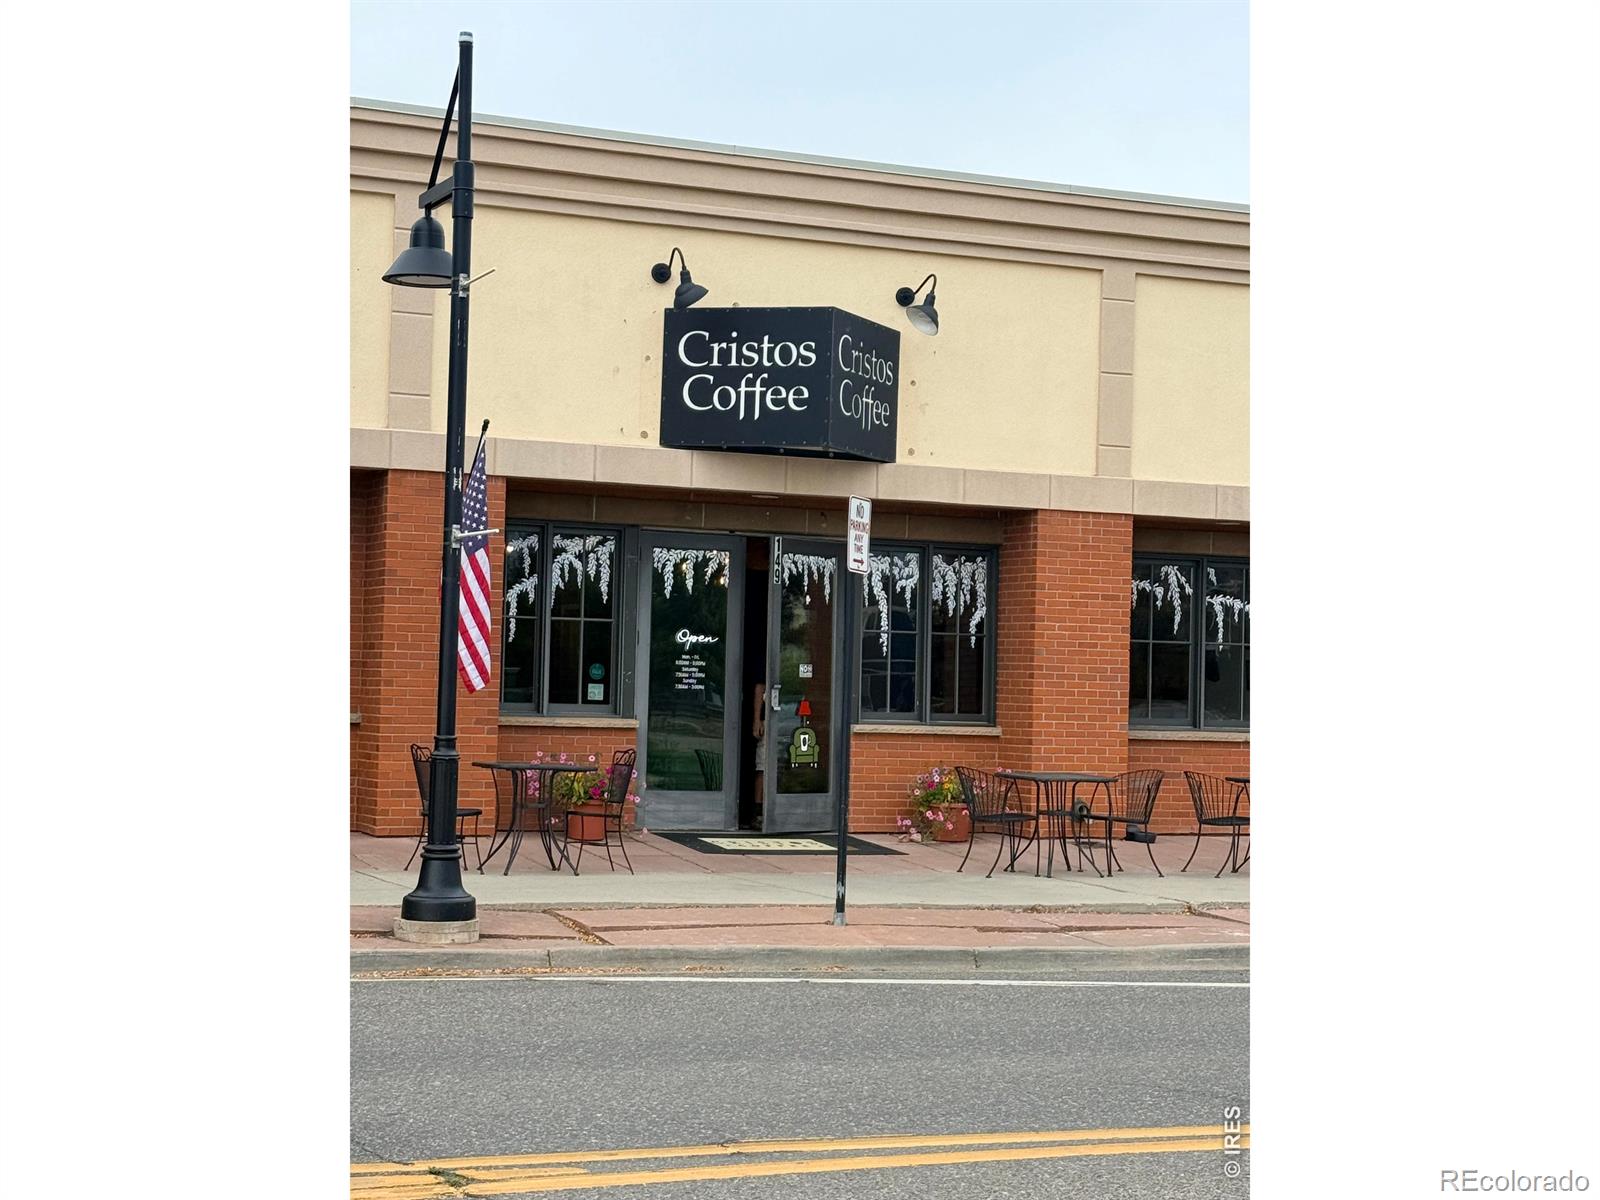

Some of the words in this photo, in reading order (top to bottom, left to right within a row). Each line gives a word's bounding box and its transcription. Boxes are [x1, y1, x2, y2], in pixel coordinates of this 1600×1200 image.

[678, 330, 817, 367] Cristos
[838, 334, 894, 386] Cristos
[682, 373, 809, 421] Coffee
[840, 379, 890, 431] Coffee
[856, 504, 865, 519] NO
[850, 520, 870, 534] PARKING
[854, 533, 864, 544] ANY
[854, 544, 864, 555] TIME
[676, 629, 719, 650] Open
